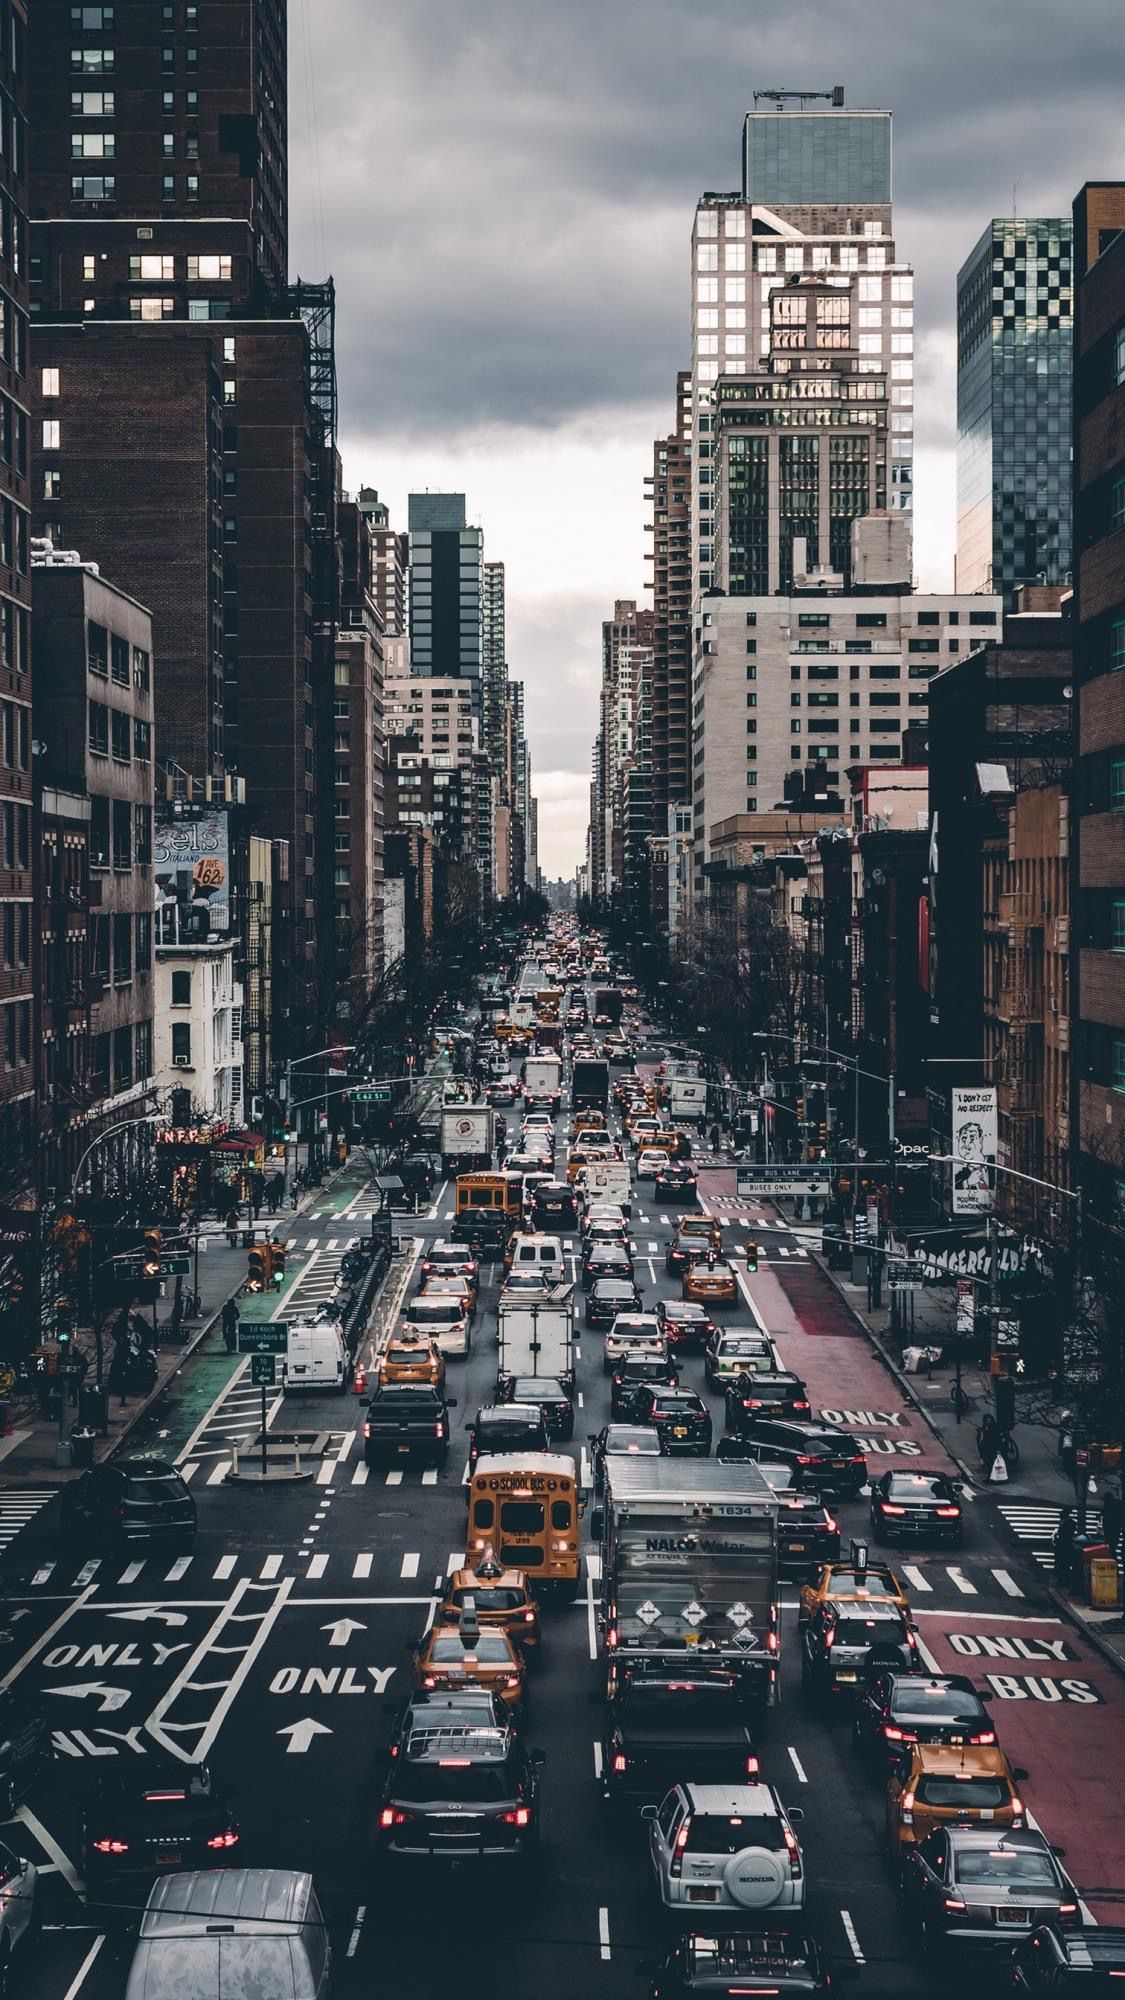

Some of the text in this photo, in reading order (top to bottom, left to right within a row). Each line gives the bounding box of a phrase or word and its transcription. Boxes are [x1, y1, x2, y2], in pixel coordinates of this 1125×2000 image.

[205, 859, 219, 868] AVE
[963, 1093, 981, 1103] DON'T
[160, 1263, 174, 1273] St
[820, 1409, 902, 1426] ONLY
[501, 1478, 545, 1490] SCHOOL BUS
[718, 1507, 752, 1515] 1634
[646, 1538, 745, 1551] NALCO Water
[949, 1633, 1069, 1661] ONLY
[42, 1642, 193, 1668] ONLY
[269, 1667, 398, 1694] ONLY
[985, 1674, 1099, 1703] BUS
[51, 1726, 148, 1758] NLY
